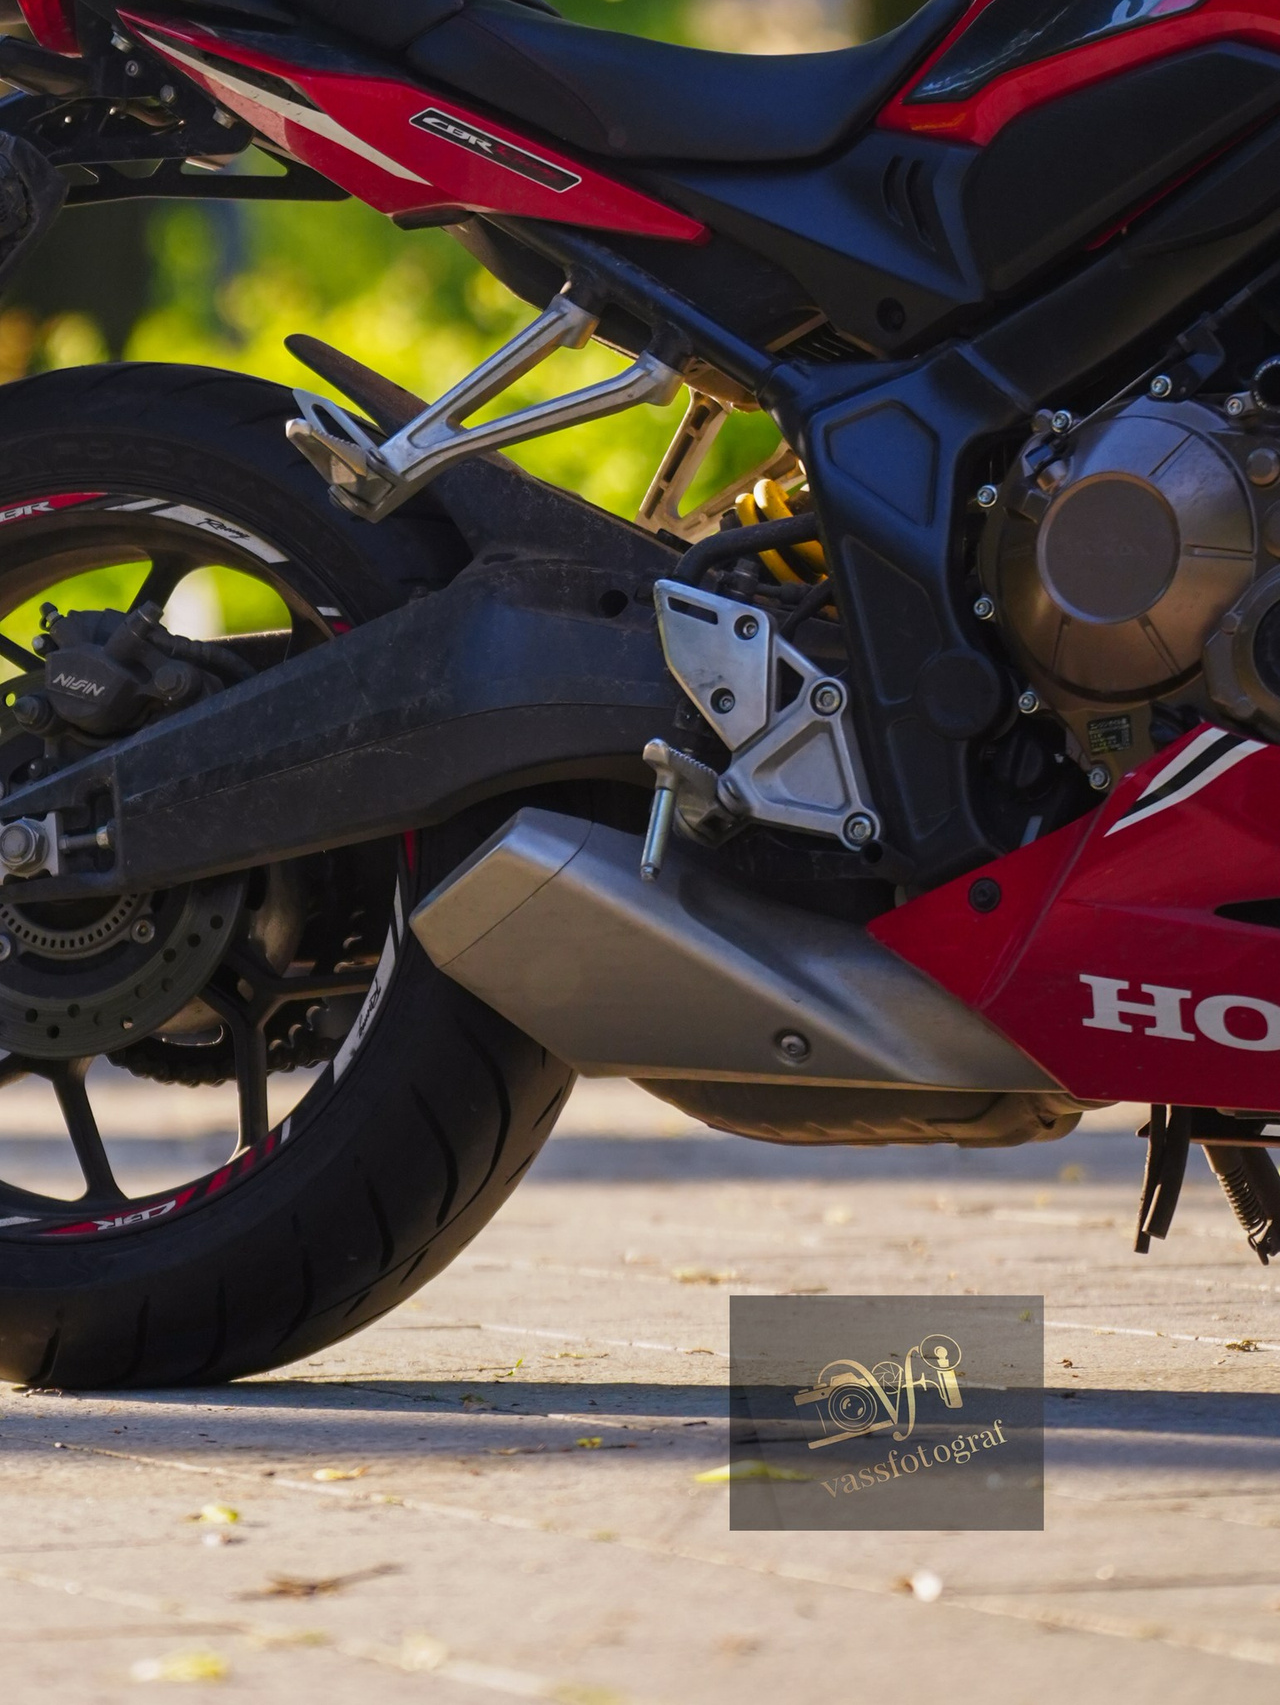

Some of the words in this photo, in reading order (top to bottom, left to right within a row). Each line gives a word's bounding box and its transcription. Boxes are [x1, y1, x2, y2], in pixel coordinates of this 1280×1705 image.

[422, 117, 494, 155] CBR
[1079, 973, 1280, 1052] HO
[92, 1199, 177, 1232] CBR
